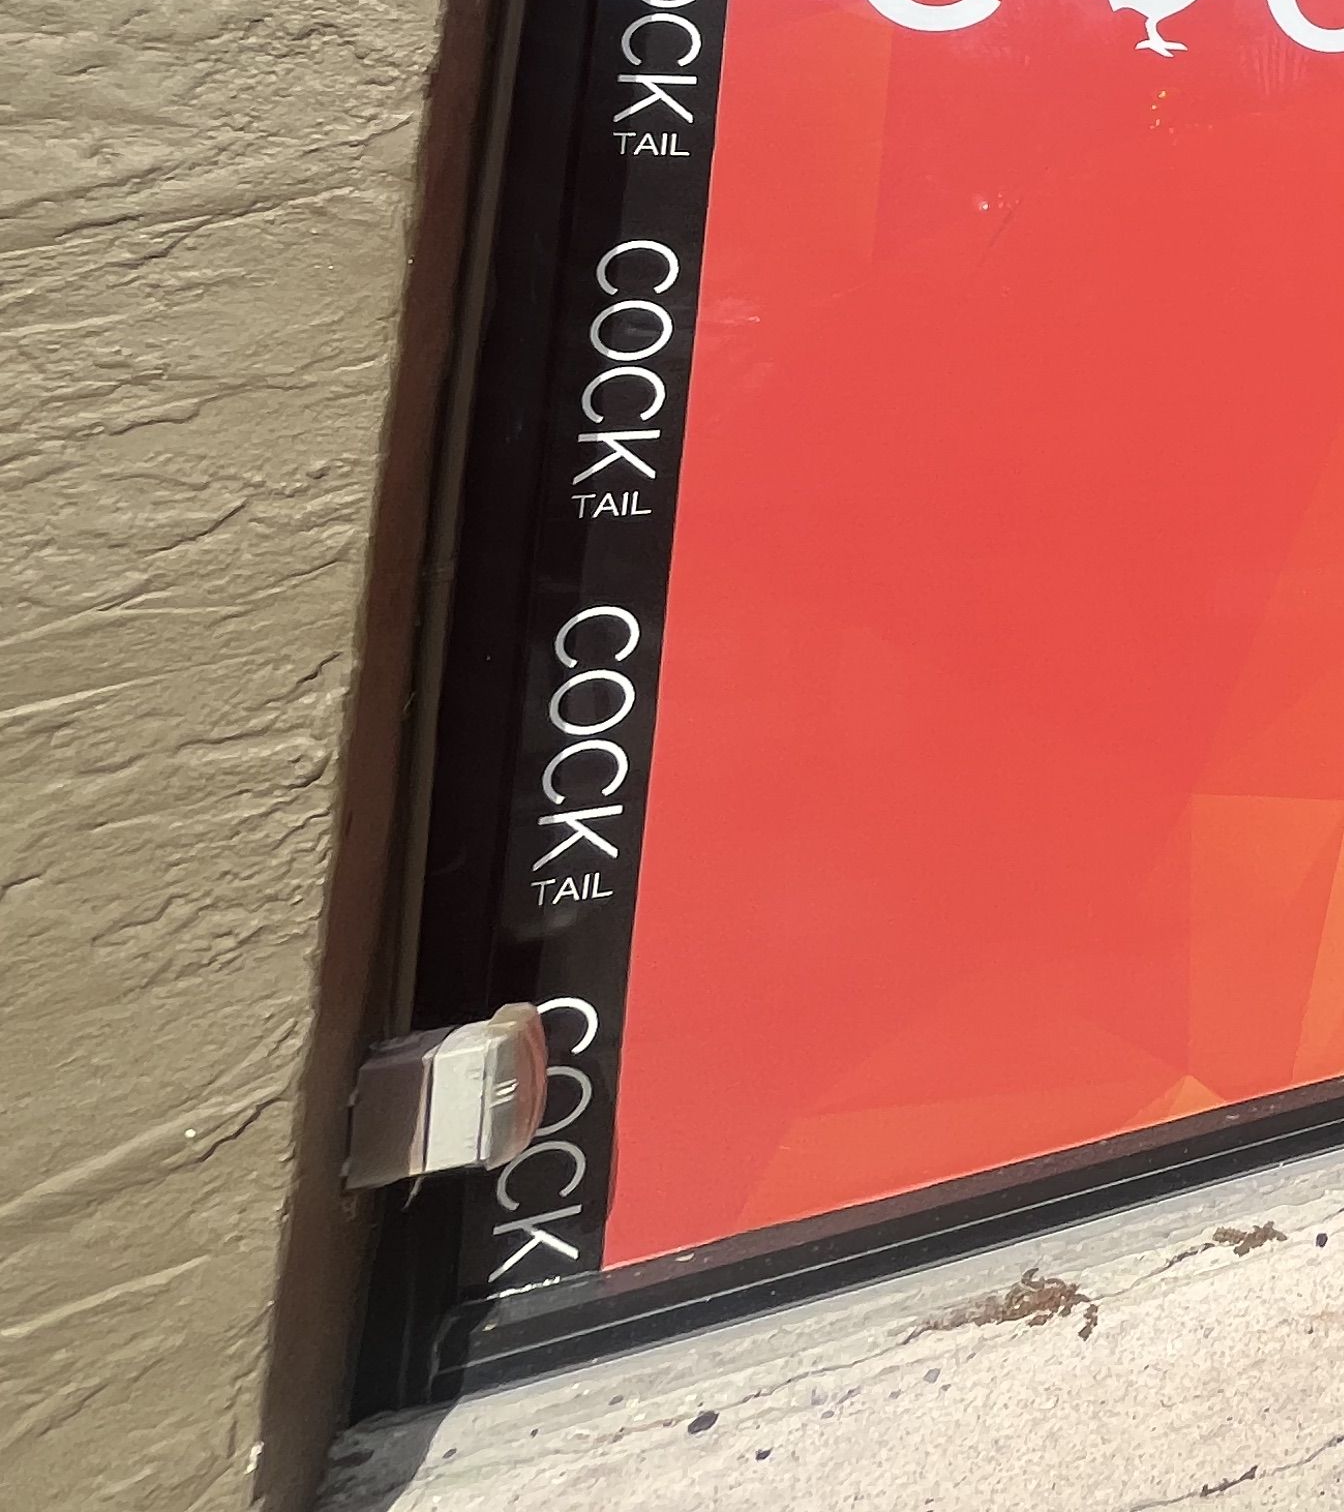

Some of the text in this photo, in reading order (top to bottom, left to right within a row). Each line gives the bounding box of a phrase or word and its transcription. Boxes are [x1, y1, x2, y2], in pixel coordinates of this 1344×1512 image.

[612, 131, 690, 156] TAIL
[572, 239, 680, 485] COCK
[571, 491, 652, 520] TAIL
[533, 605, 641, 873] COCK
[531, 872, 614, 907] TAIL
